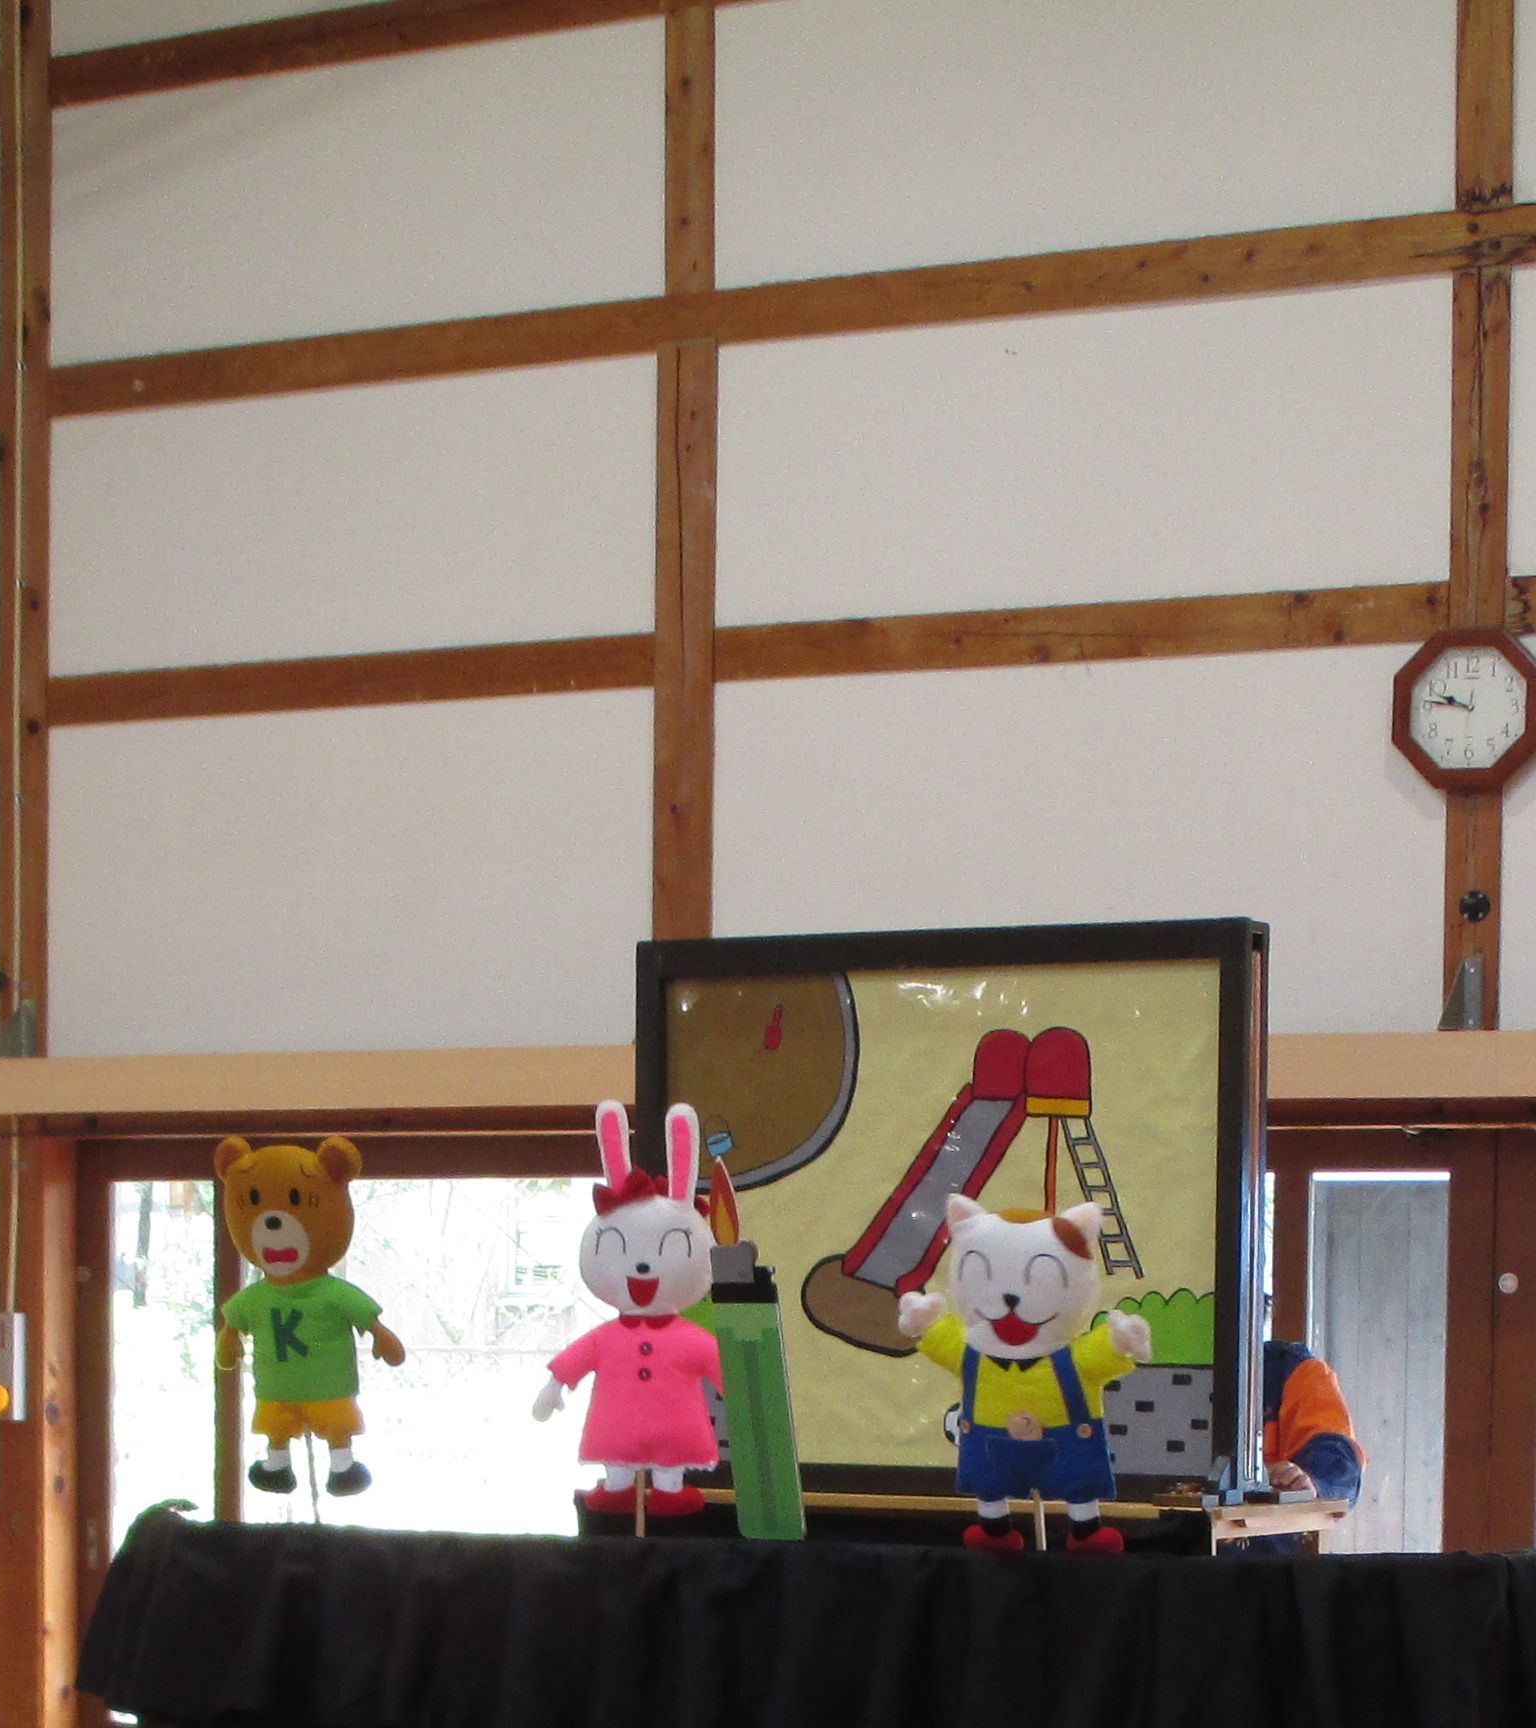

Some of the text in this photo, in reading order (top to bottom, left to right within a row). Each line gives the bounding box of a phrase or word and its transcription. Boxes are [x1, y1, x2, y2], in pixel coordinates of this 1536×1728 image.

[1446, 662, 1458, 679] 11
[1466, 656, 1480, 673] 12
[1491, 658, 1496, 677] 1
[1505, 676, 1514, 692] 2
[1511, 698, 1520, 714] 3
[1428, 723, 1438, 739] 8
[1501, 722, 1511, 738] 4
[1445, 738, 1453, 756] 7
[1464, 743, 1474, 760] 6
[1487, 736, 1496, 753] 5
[270, 1307, 309, 1362] K
